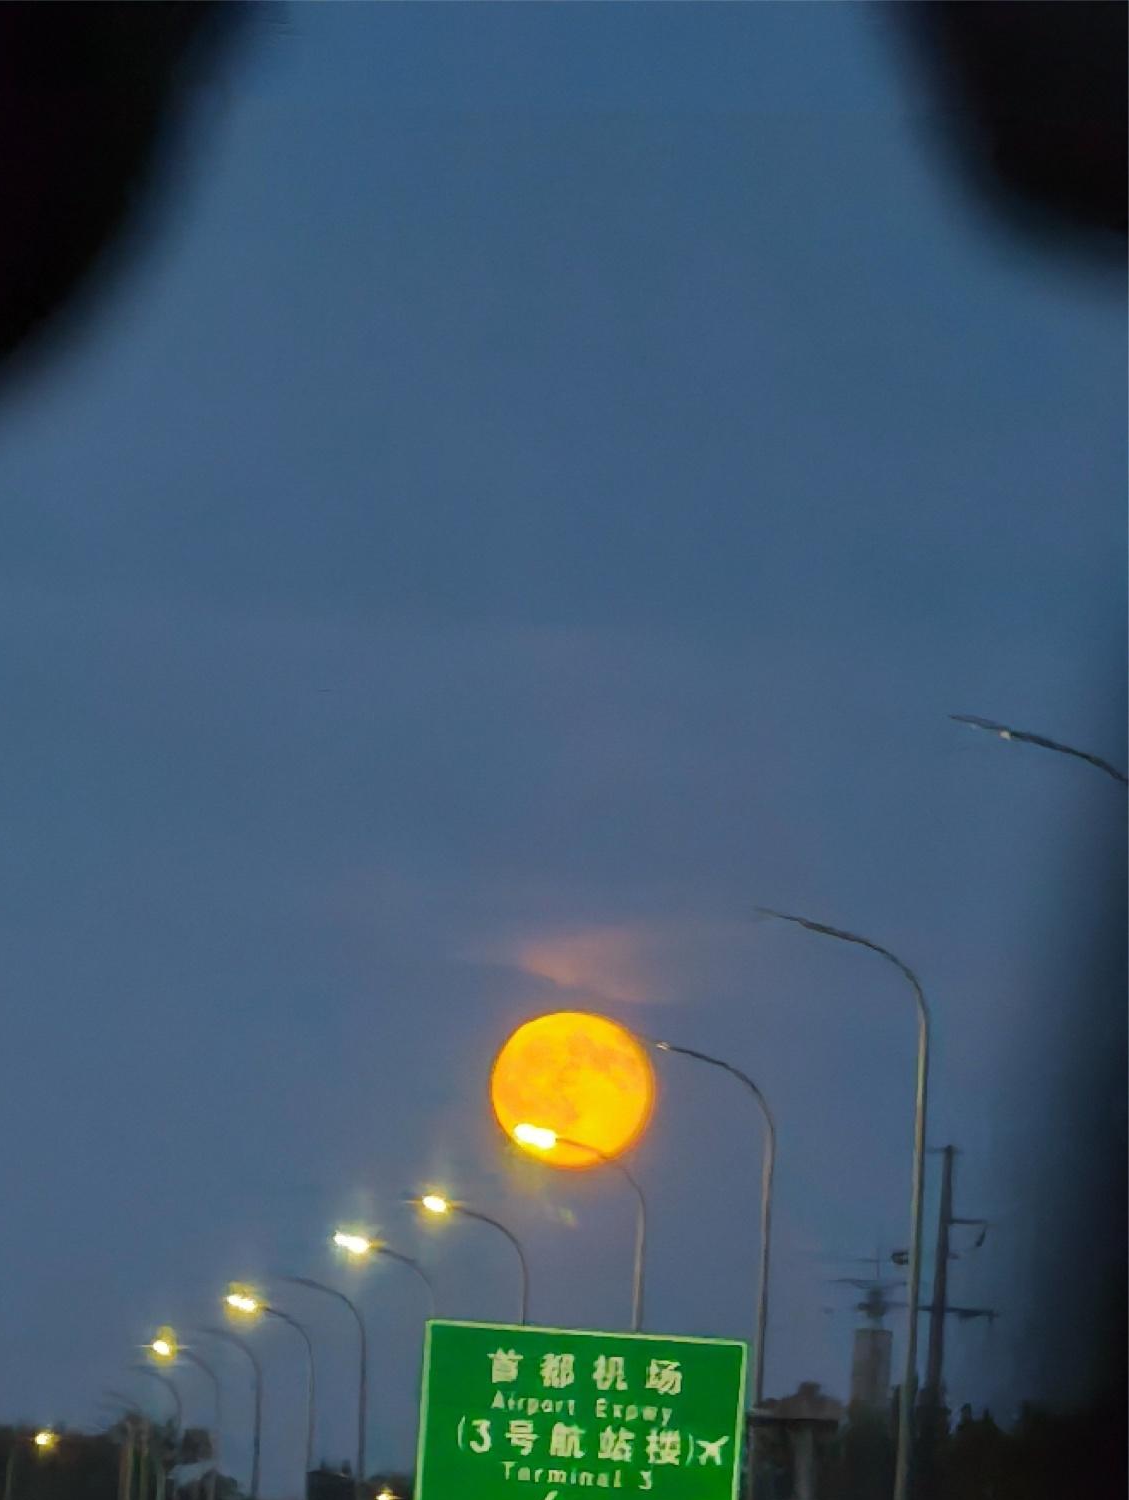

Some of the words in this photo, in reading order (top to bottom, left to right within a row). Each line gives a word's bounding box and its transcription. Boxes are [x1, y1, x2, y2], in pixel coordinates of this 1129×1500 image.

[487, 1347, 682, 1395] 首都机场
[491, 1390, 575, 1416] Airport
[501, 1461, 622, 1488] Terminal
[638, 1470, 653, 1490] 3
